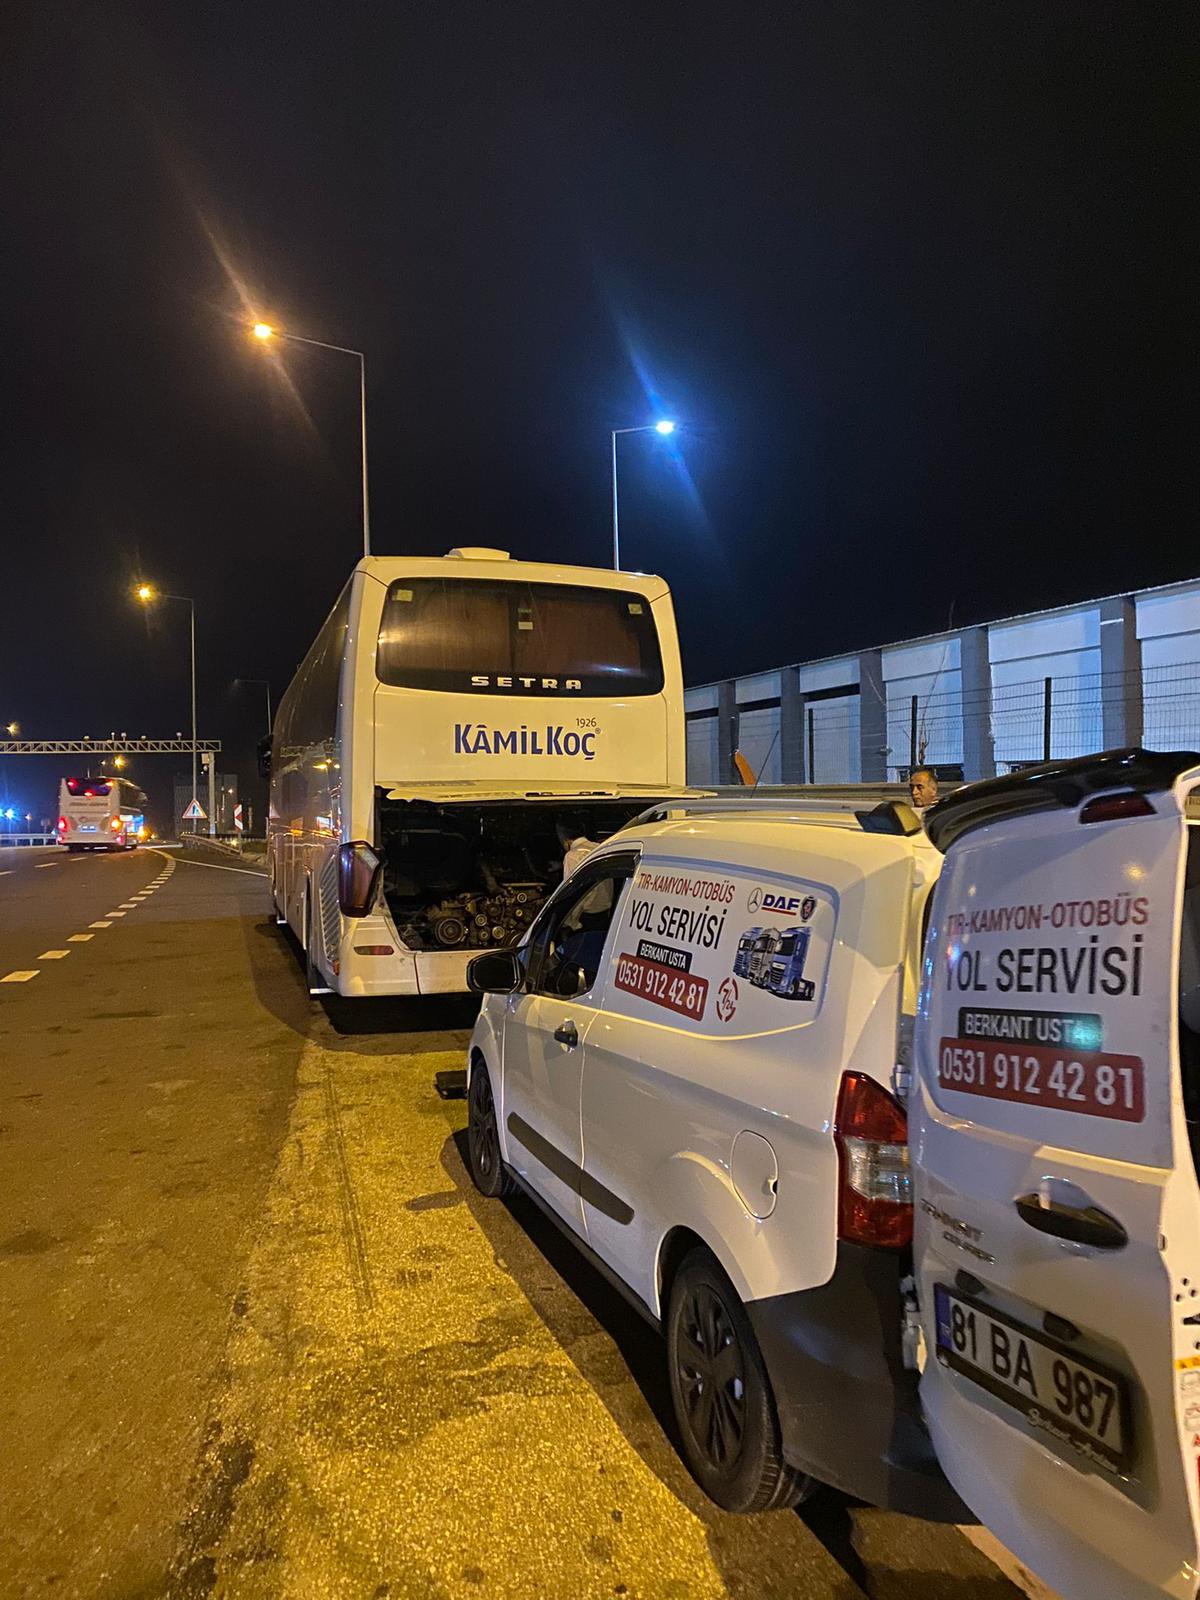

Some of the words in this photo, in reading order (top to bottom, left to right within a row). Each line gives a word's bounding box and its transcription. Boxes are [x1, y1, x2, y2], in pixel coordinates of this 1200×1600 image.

[471, 676, 582, 690] SETRA
[575, 717, 597, 728] 1926
[762, 894, 801, 911] DAF
[629, 899, 656, 933] YOL
[657, 905, 728, 950] SERVİSİ
[640, 942, 670, 964] BERKANT
[669, 952, 687, 969] USTA
[996, 934, 1144, 996] SERVİSİ
[618, 959, 644, 992] 0531
[646, 969, 666, 998] 912
[668, 976, 687, 1004] 42
[688, 983, 704, 1013] 81
[965, 1013, 1033, 1040] BERKANT
[942, 1047, 986, 1086] 0531
[993, 1053, 1041, 1095] 912
[1047, 1060, 1087, 1102] 42
[1094, 1065, 1135, 1109] 81
[951, 1304, 977, 1360] 81
[990, 1323, 1039, 1398] BA
[1053, 1360, 1116, 1438] 987
